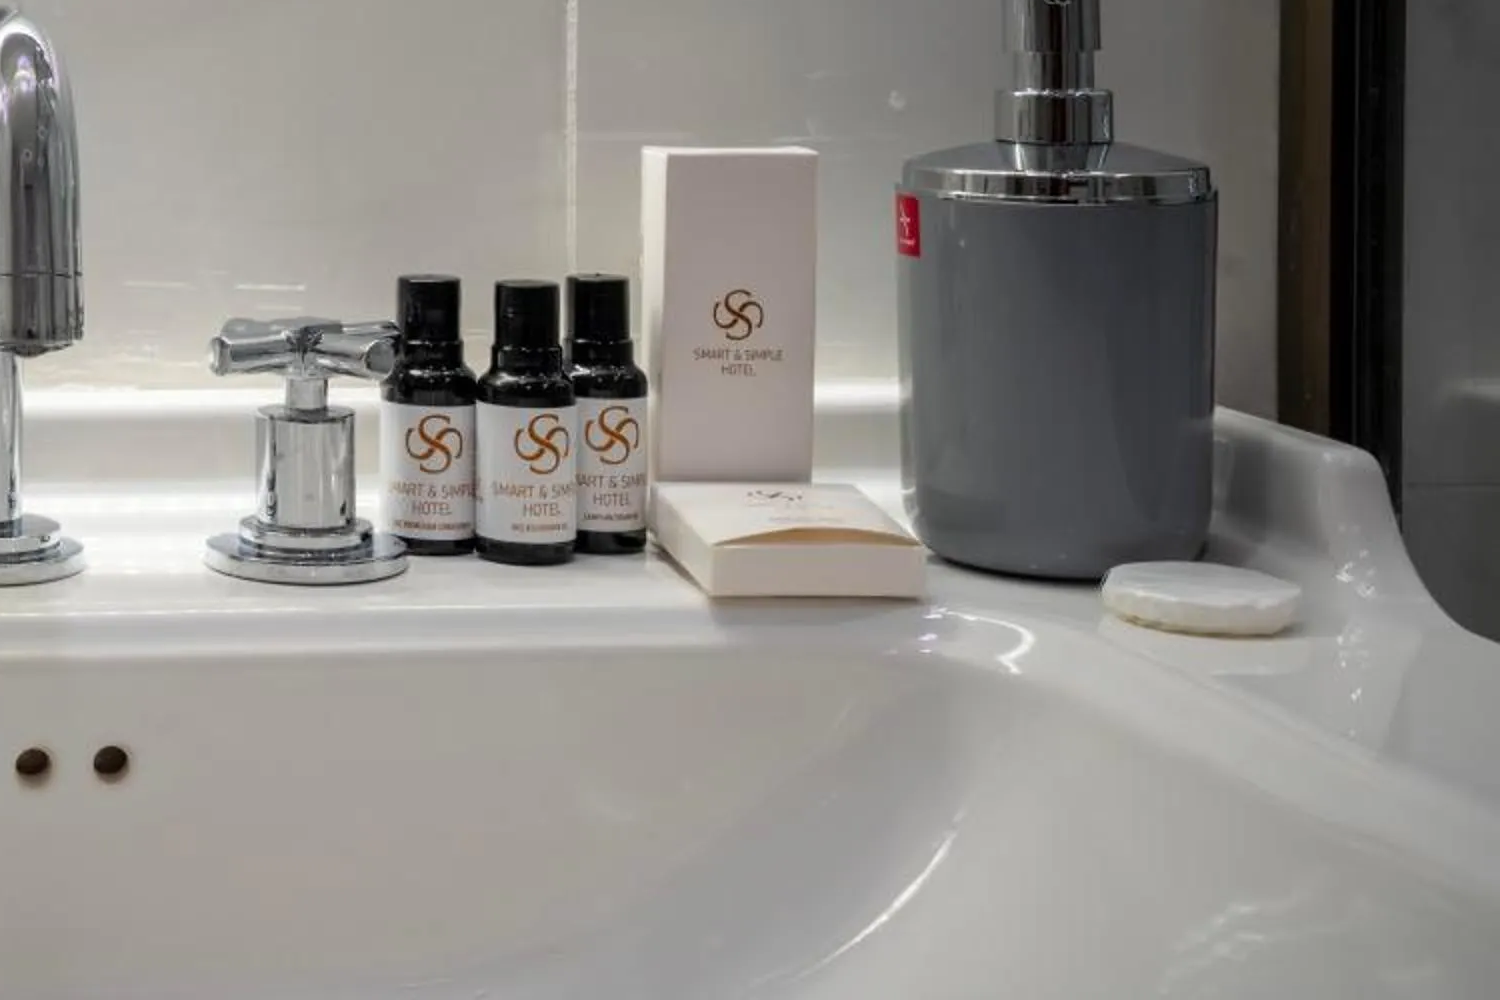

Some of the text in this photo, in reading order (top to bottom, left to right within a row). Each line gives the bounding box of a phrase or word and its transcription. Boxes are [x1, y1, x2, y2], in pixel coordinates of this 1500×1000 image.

[692, 347, 784, 361] SMART & SIMPLE
[721, 363, 757, 376] HOTEL
[608, 476, 617, 489] &
[427, 484, 437, 498] &
[539, 484, 548, 499] &
[593, 493, 631, 507] HOTEL
[412, 501, 453, 515] HOTEL
[523, 503, 561, 517] HOTEL
